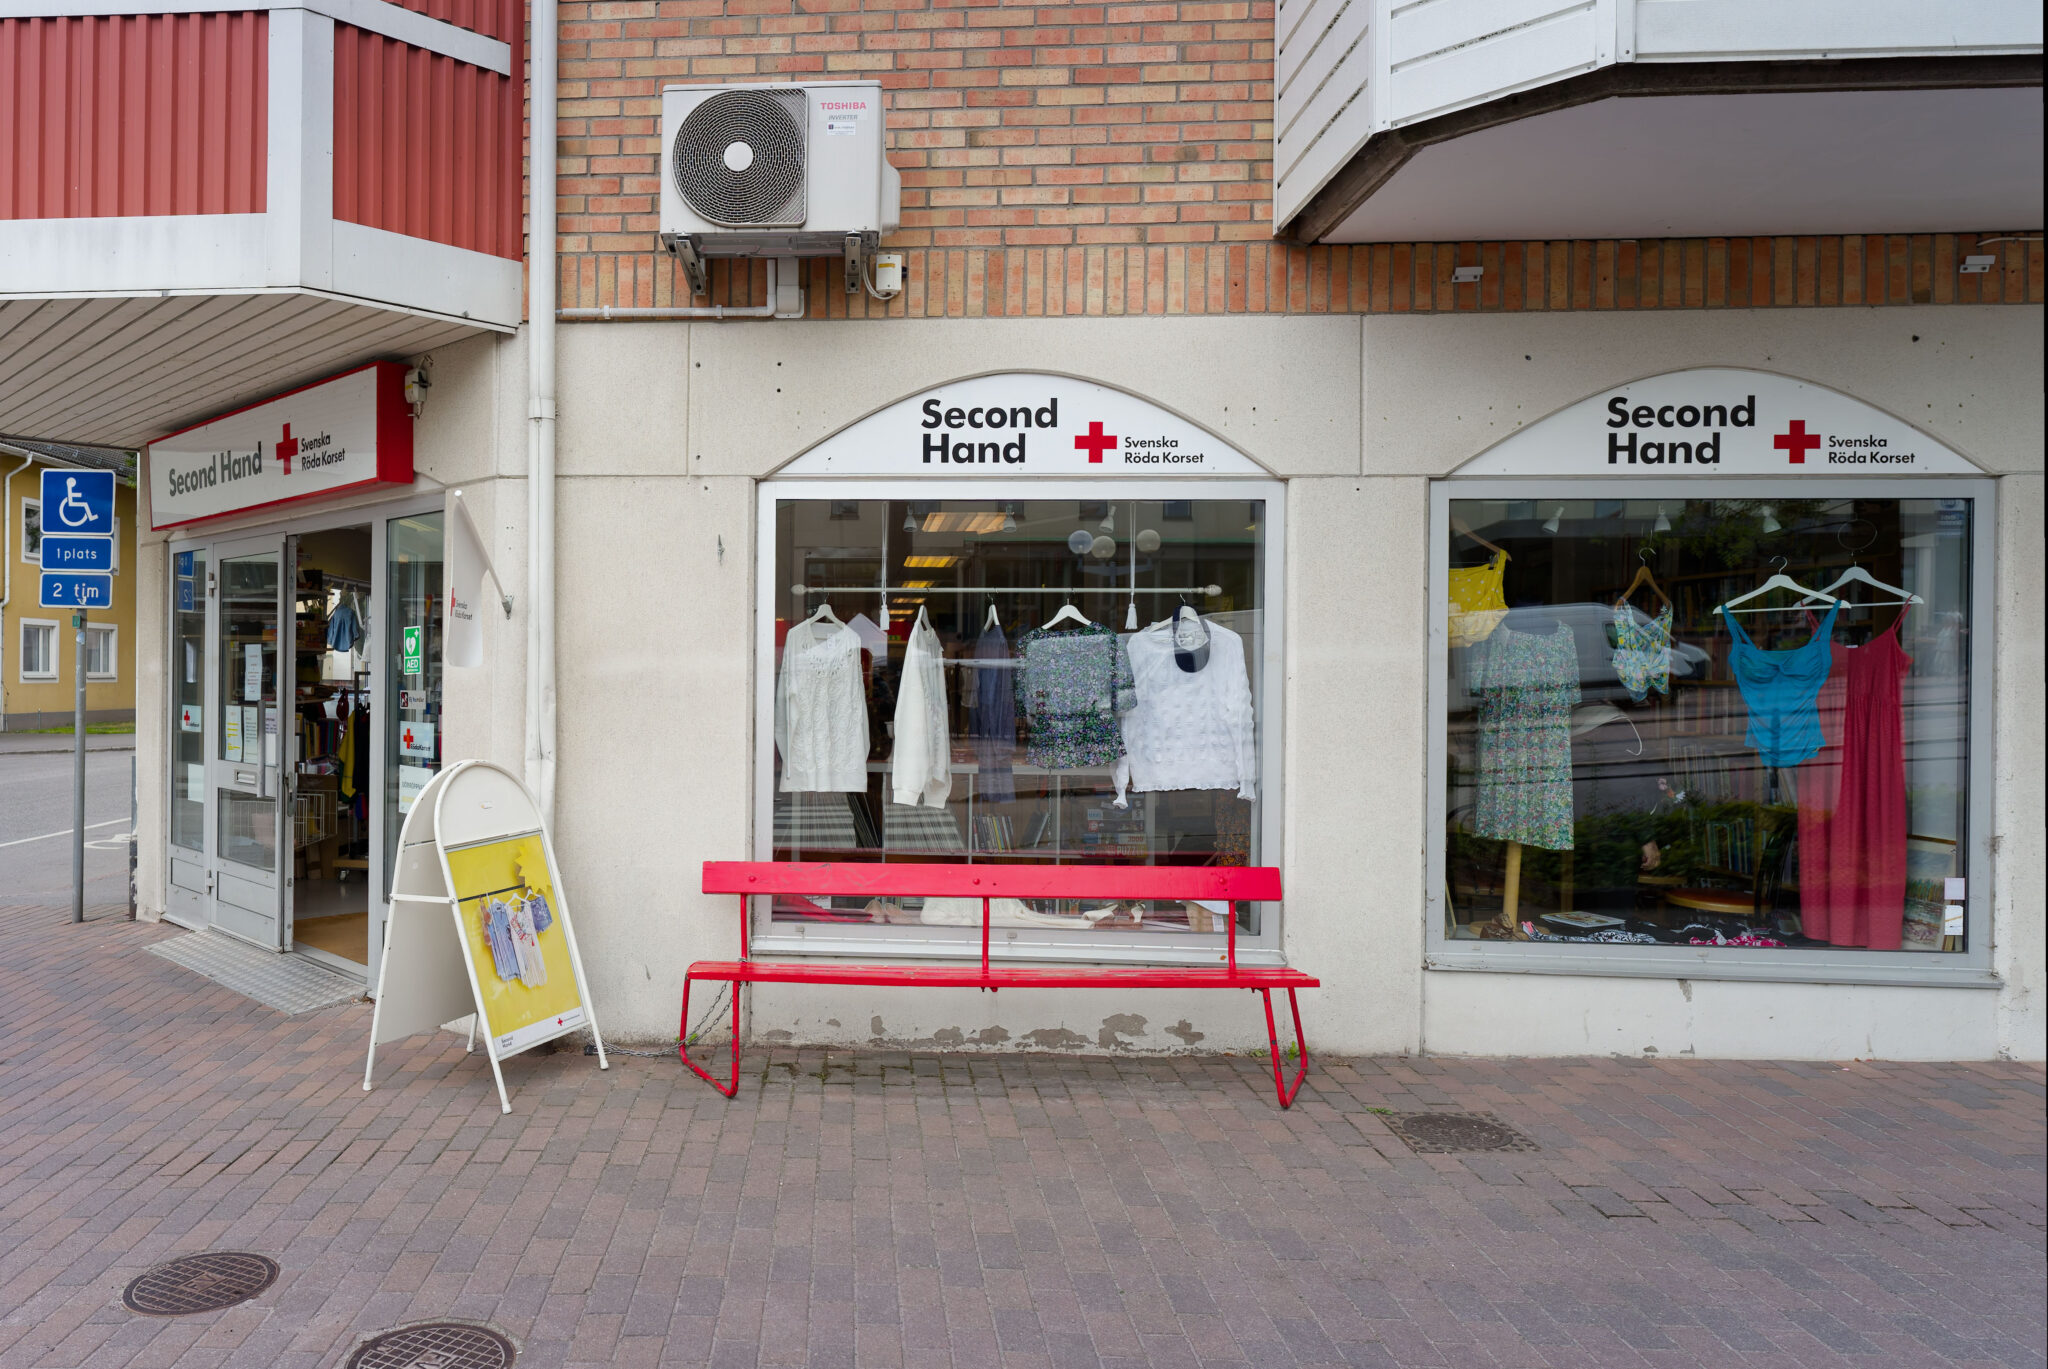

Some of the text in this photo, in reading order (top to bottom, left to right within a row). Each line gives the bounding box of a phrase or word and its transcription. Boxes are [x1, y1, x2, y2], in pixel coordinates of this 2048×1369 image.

[820, 102, 867, 110] TOSHIBA
[921, 397, 1058, 429] Second
[1606, 394, 1756, 428] Second
[301, 431, 331, 452] Svenska
[922, 432, 1026, 464] Hand
[1125, 436, 1179, 448] Svenska
[1607, 431, 1721, 464] Hand
[1828, 434, 1887, 448] Svenska
[301, 448, 345, 471] Röda Korset
[1125, 452, 1205, 464] Röda Korset
[1828, 451, 1915, 464] Röda Korset
[169, 440, 262, 497] Second Hand
[57, 548, 97, 562] 1 plats
[53, 583, 99, 598] 2 tim
[407, 660, 418, 668] AED
